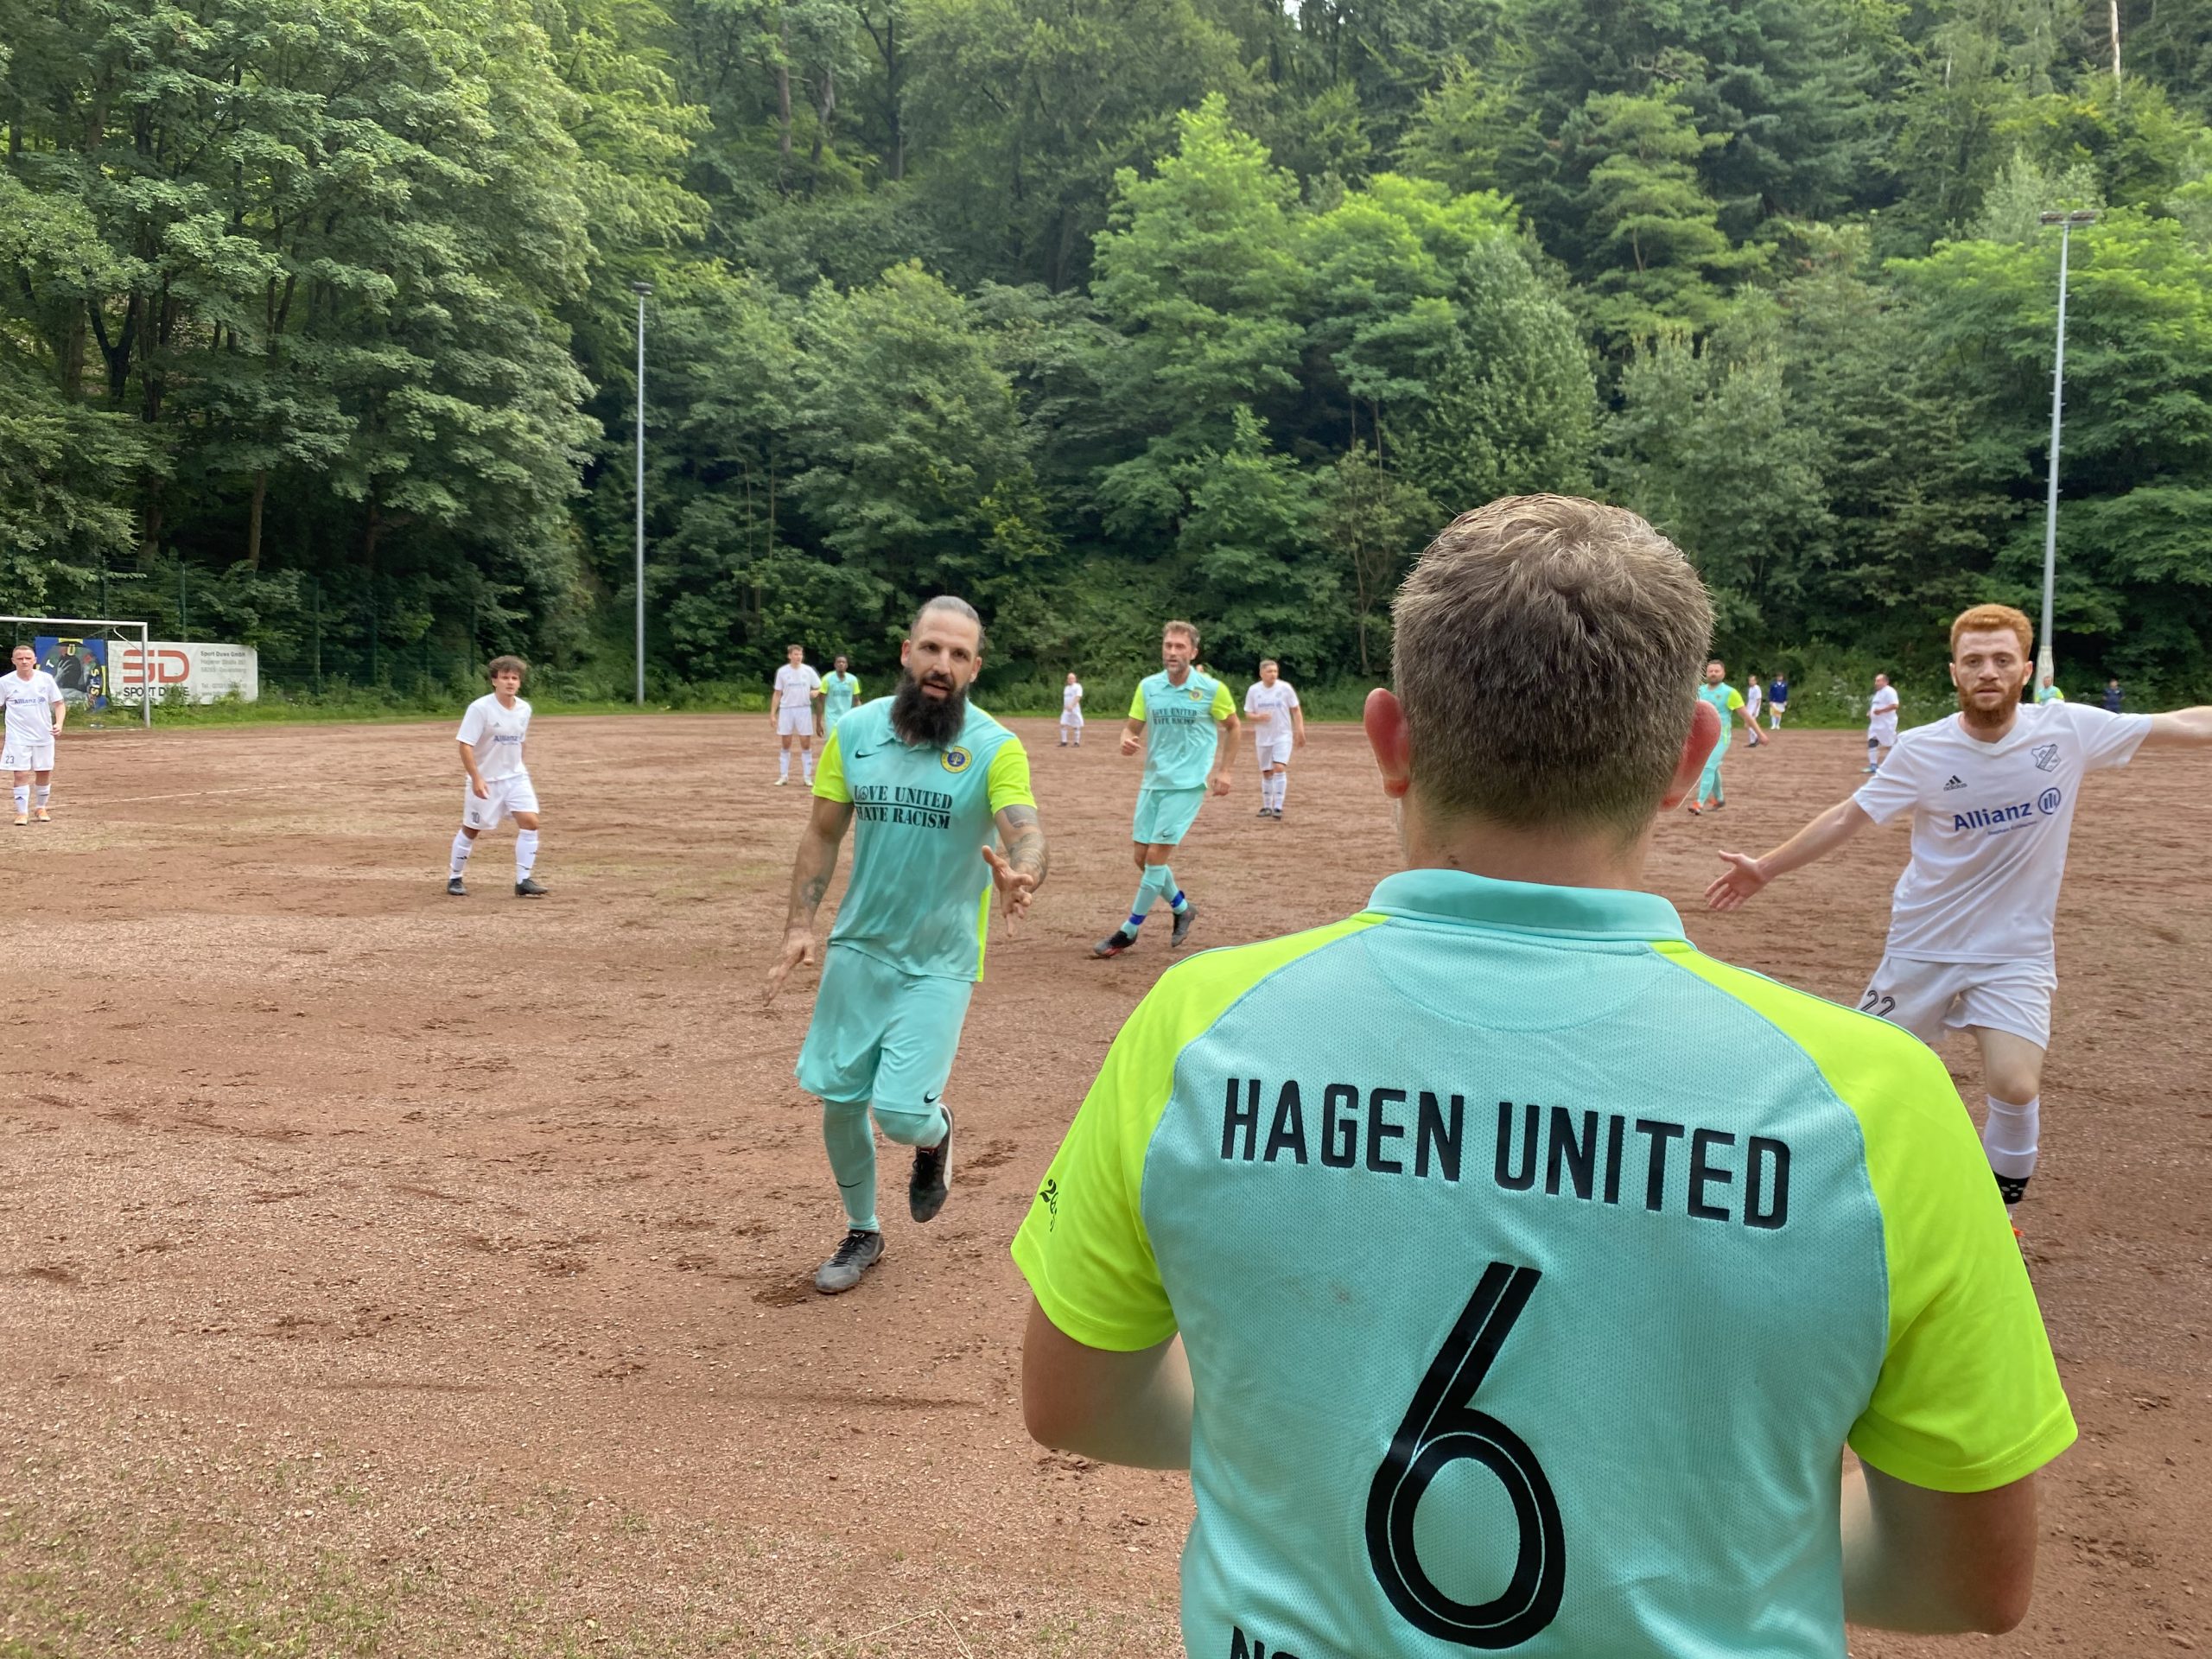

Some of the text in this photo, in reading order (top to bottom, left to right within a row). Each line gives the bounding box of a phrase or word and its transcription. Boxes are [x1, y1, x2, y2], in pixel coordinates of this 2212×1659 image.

[124, 687, 156, 696] SPOT
[5, 755, 15, 764] 23
[854, 785, 953, 810] LOVE UNITED
[471, 811, 480, 823] 10
[855, 806, 951, 830] HATE RACISM
[1953, 803, 2032, 830] Allianz
[1860, 989, 1896, 1017] 22
[1221, 1078, 1790, 1230] HAGEN UNITED
[1365, 1262, 1566, 1649] 6
